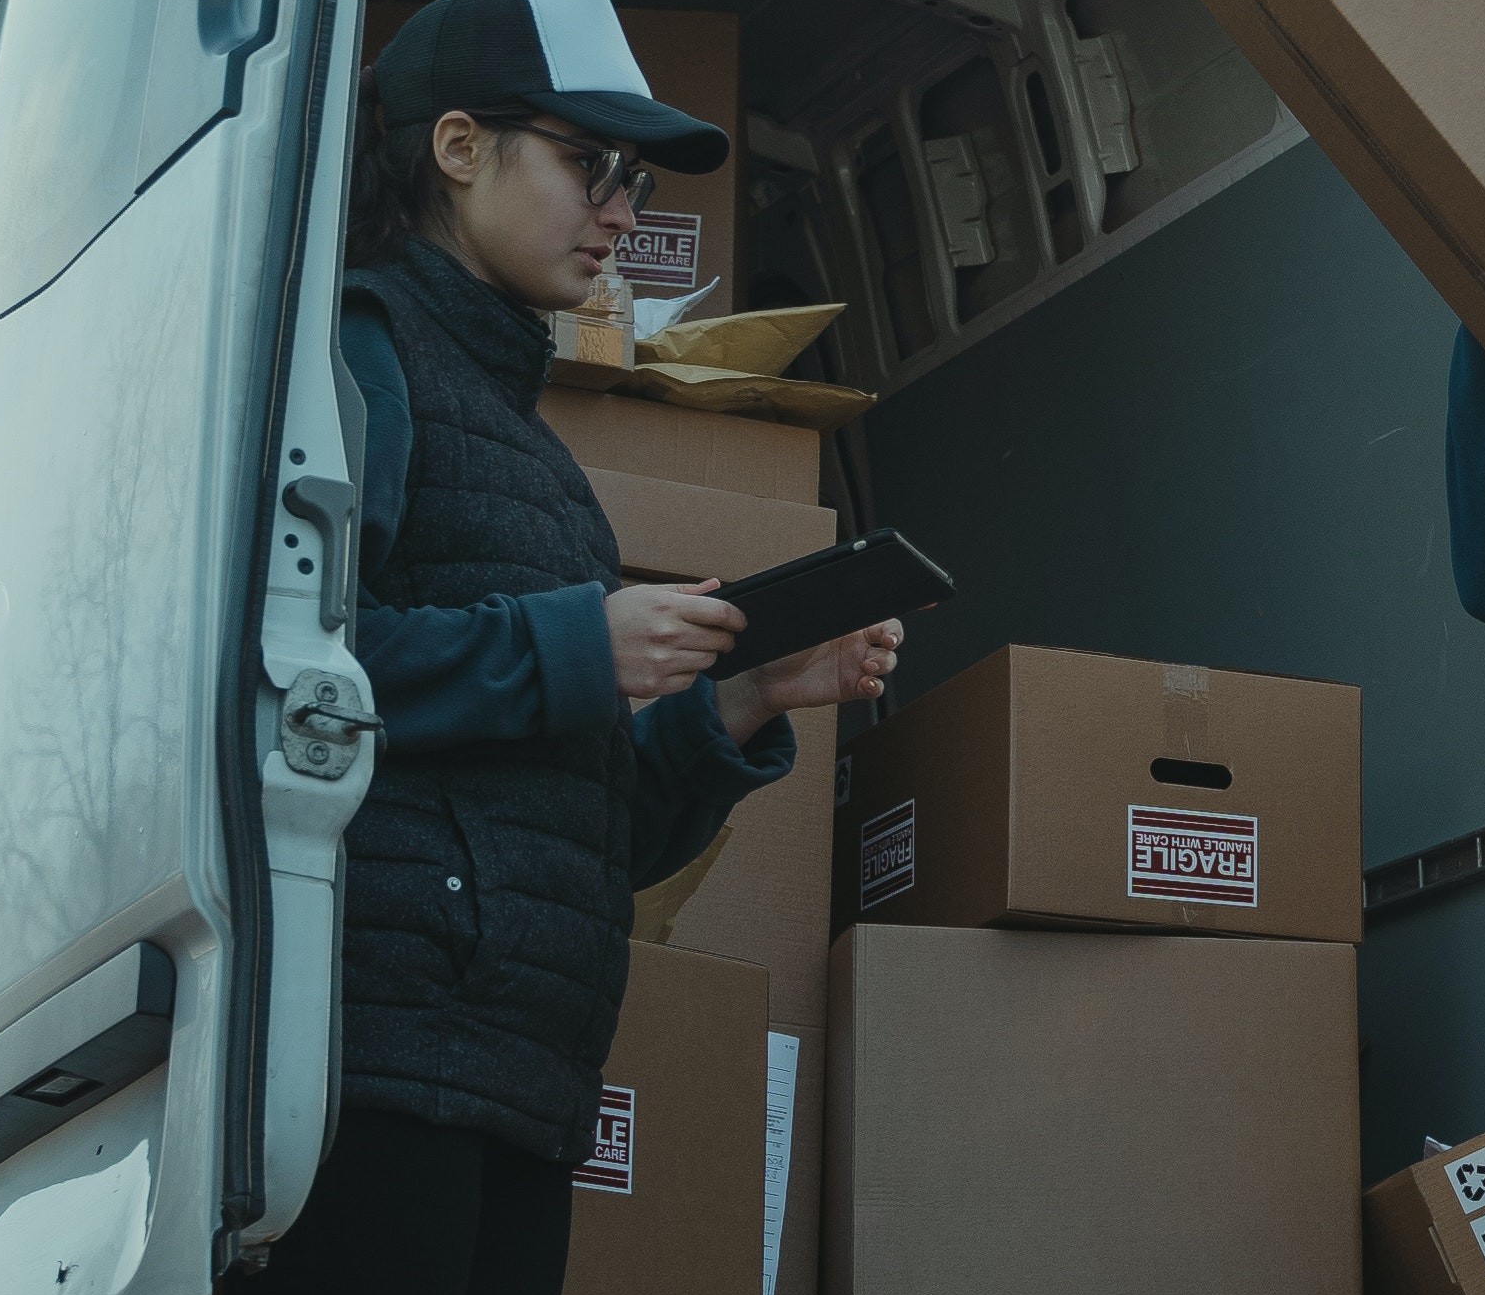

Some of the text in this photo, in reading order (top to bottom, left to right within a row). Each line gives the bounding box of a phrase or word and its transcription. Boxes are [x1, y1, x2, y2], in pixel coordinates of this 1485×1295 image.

[615, 233, 693, 256] AGILE
[629, 252, 657, 263] WITH
[659, 255, 691, 267] CARE
[1135, 833, 1252, 854] HANDLE WITH CARE
[864, 837, 912, 881] FRAGILE
[1135, 845, 1252, 878] FRAGILE
[595, 1146, 627, 1162] CARE
